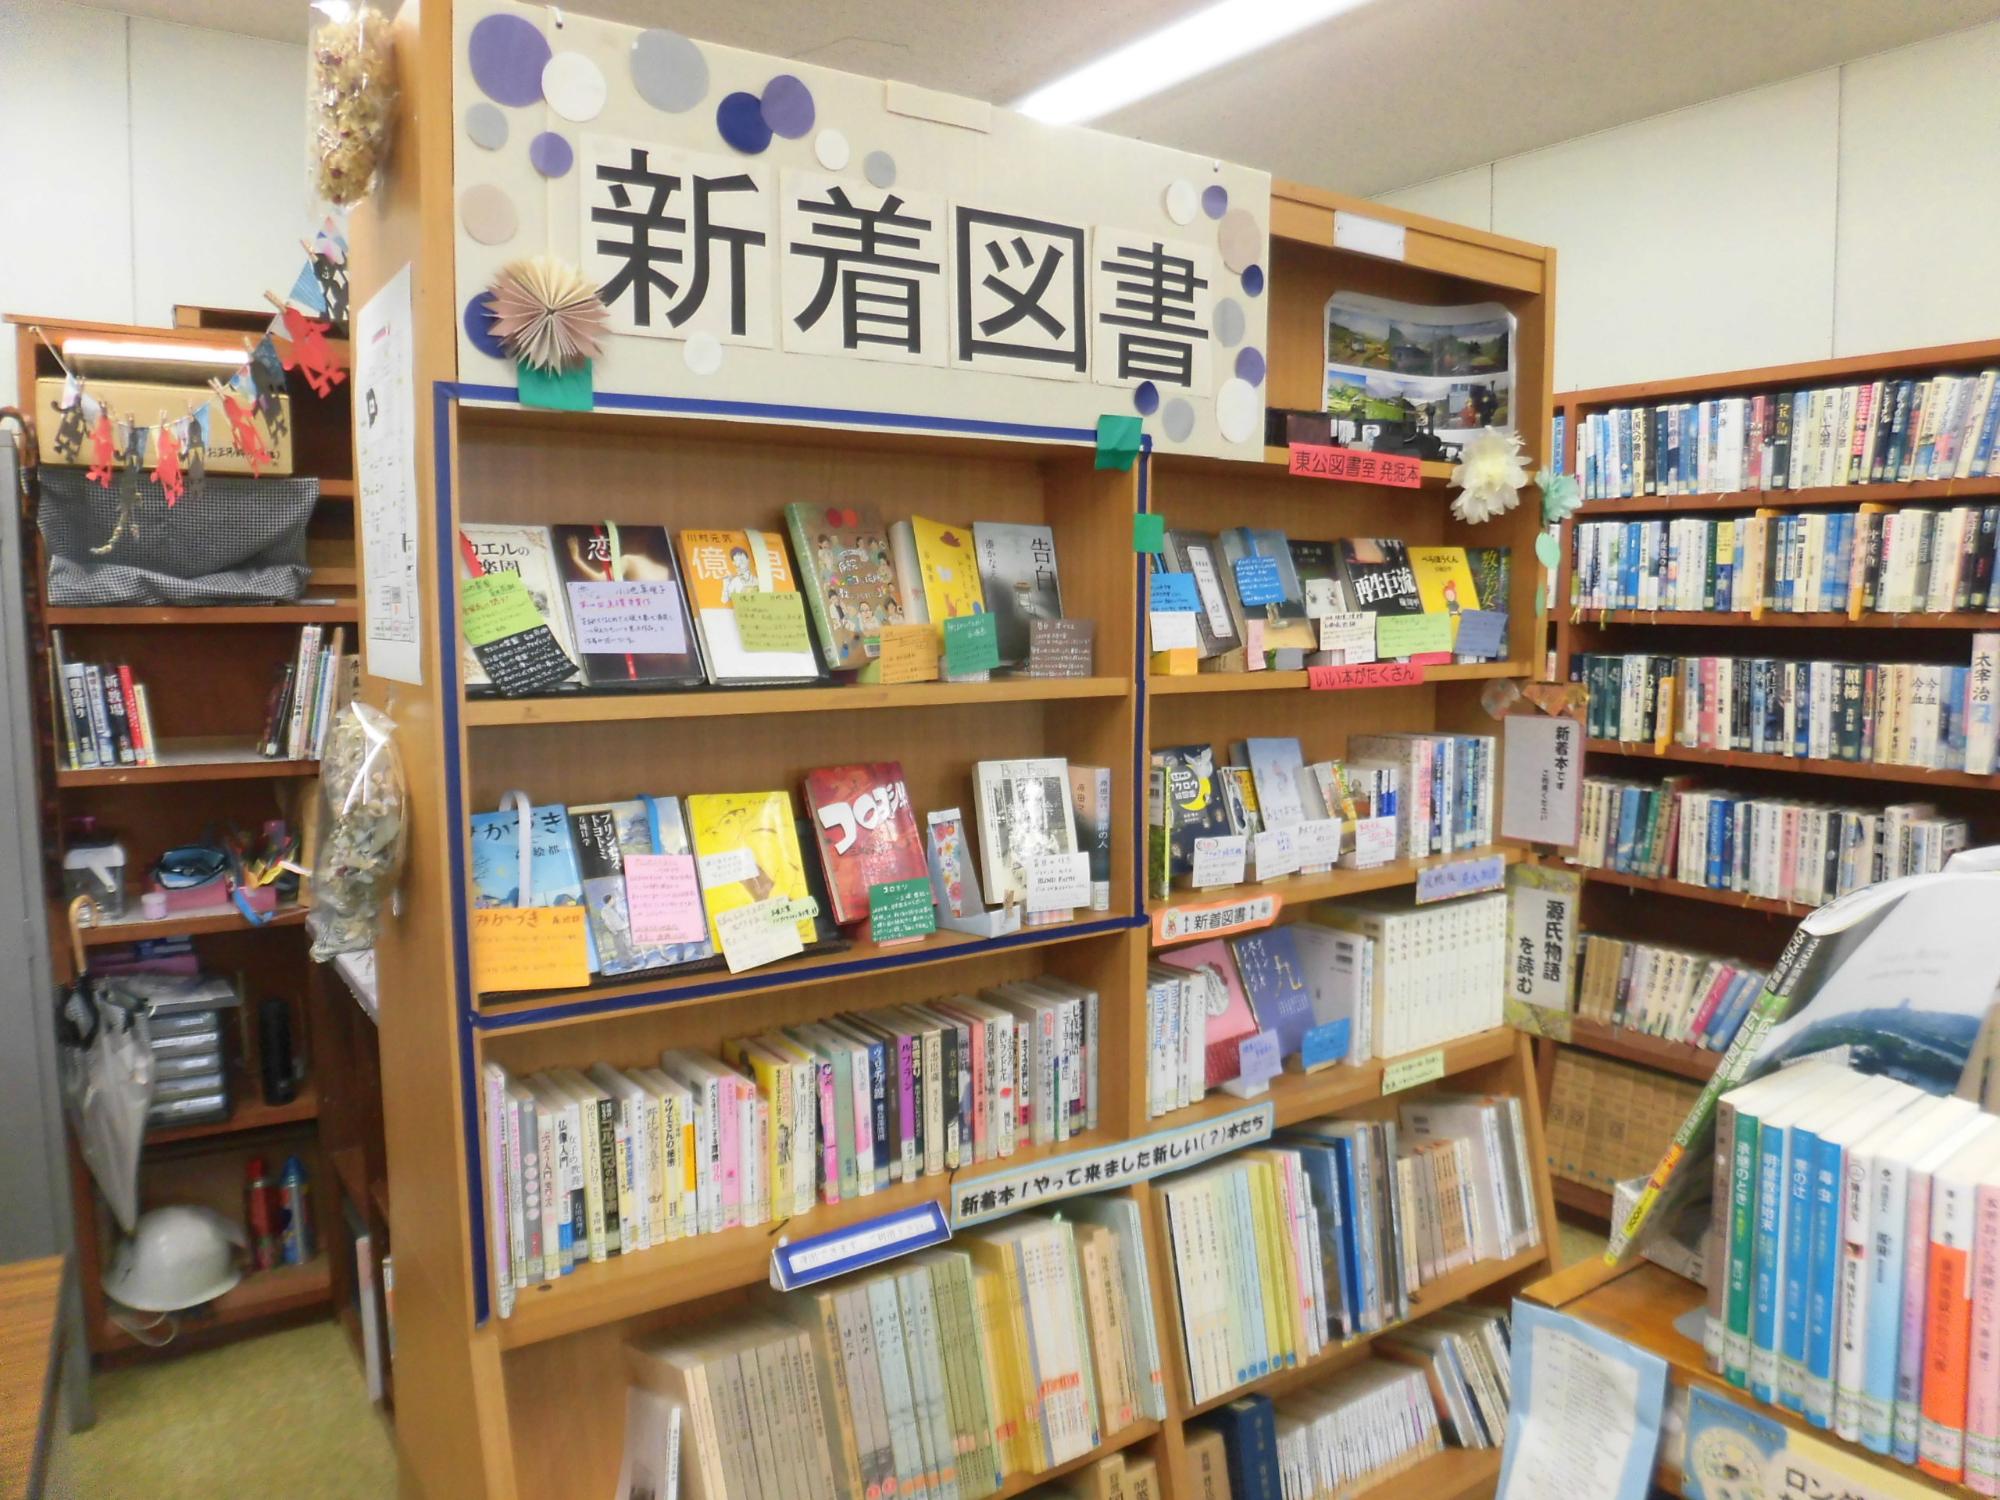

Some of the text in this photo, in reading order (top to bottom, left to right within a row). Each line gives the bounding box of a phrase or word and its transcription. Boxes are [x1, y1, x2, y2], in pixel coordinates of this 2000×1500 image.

[591, 148, 1208, 388] 新着図書
[1295, 451, 1376, 478] 東公図書室
[1356, 568, 1416, 604] 再生巨流
[1315, 669, 1416, 686] いい本がたくさん
[1972, 652, 1992, 702] 太宰治
[1193, 907, 1247, 931] 新着図書
[1543, 899, 1564, 983] 源氏物語
